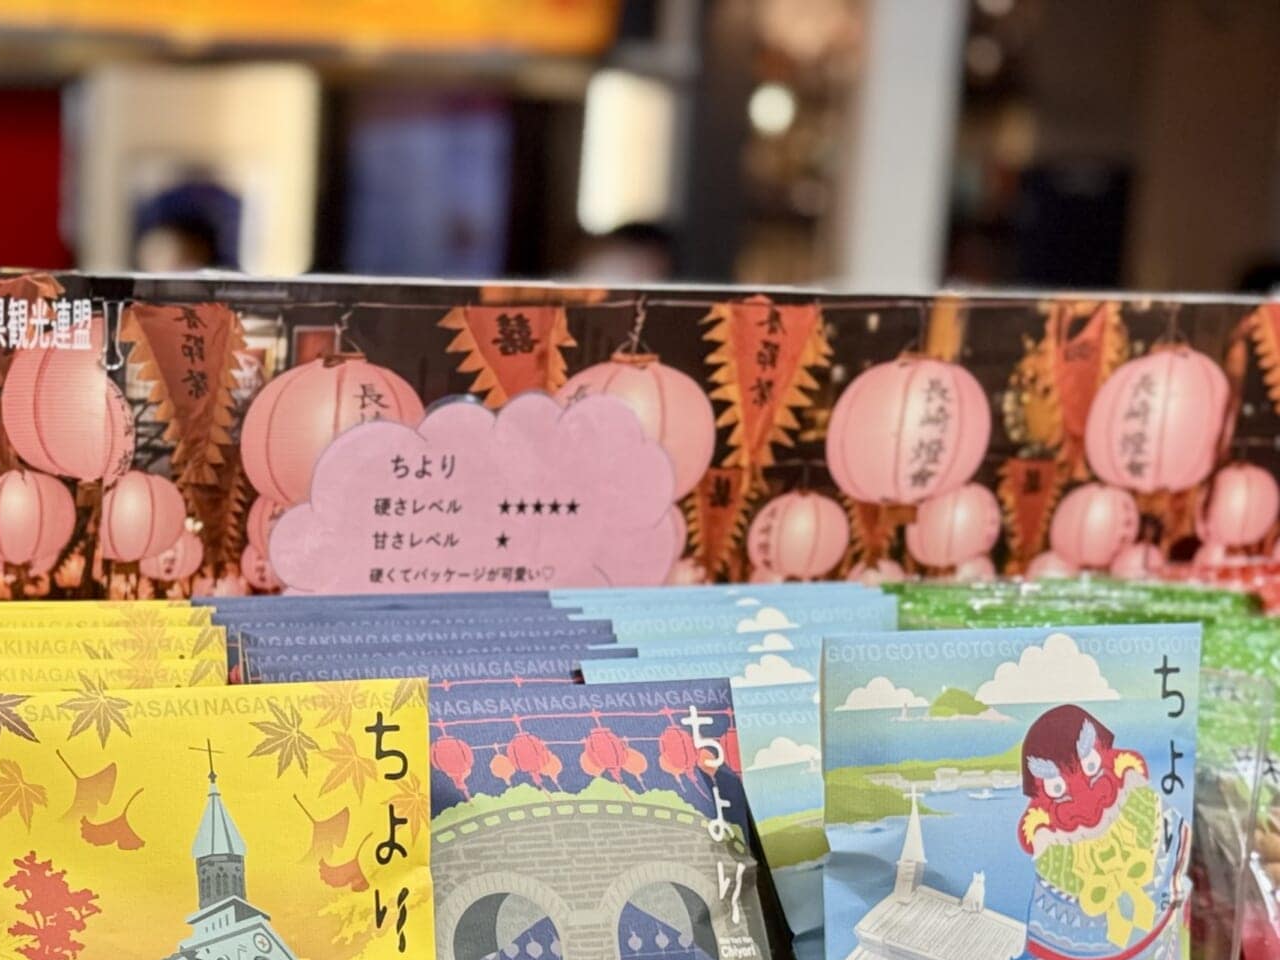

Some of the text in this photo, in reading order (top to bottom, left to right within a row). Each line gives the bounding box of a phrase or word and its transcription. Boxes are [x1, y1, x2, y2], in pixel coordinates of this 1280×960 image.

[391, 454, 457, 480] ちより
[374, 498, 463, 516] 硬さレベル
[372, 531, 461, 550] 甘さレベル
[826, 645, 881, 663] GOTO
[886, 642, 939, 662] GOTO
[942, 640, 994, 660] GOTO
[429, 696, 528, 716] NAGASAKI
[534, 692, 640, 711] NAGASAKI
[681, 705, 746, 925] ちより
[364, 711, 410, 954] ちより
